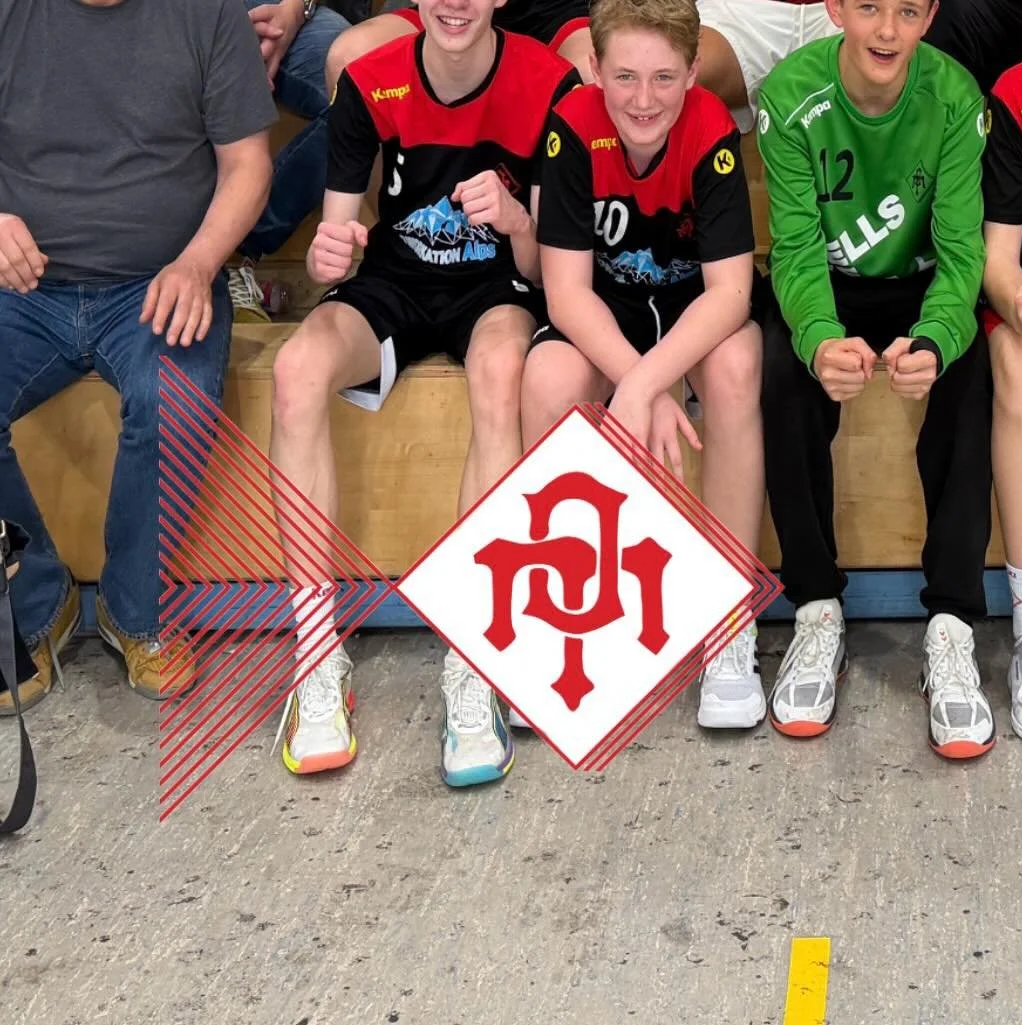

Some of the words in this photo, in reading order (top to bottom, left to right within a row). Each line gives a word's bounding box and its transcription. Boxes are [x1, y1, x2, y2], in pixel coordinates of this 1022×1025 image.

[816, 148, 855, 203] 12
[462, 239, 497, 262] Alps
[826, 193, 906, 266] ELLS
